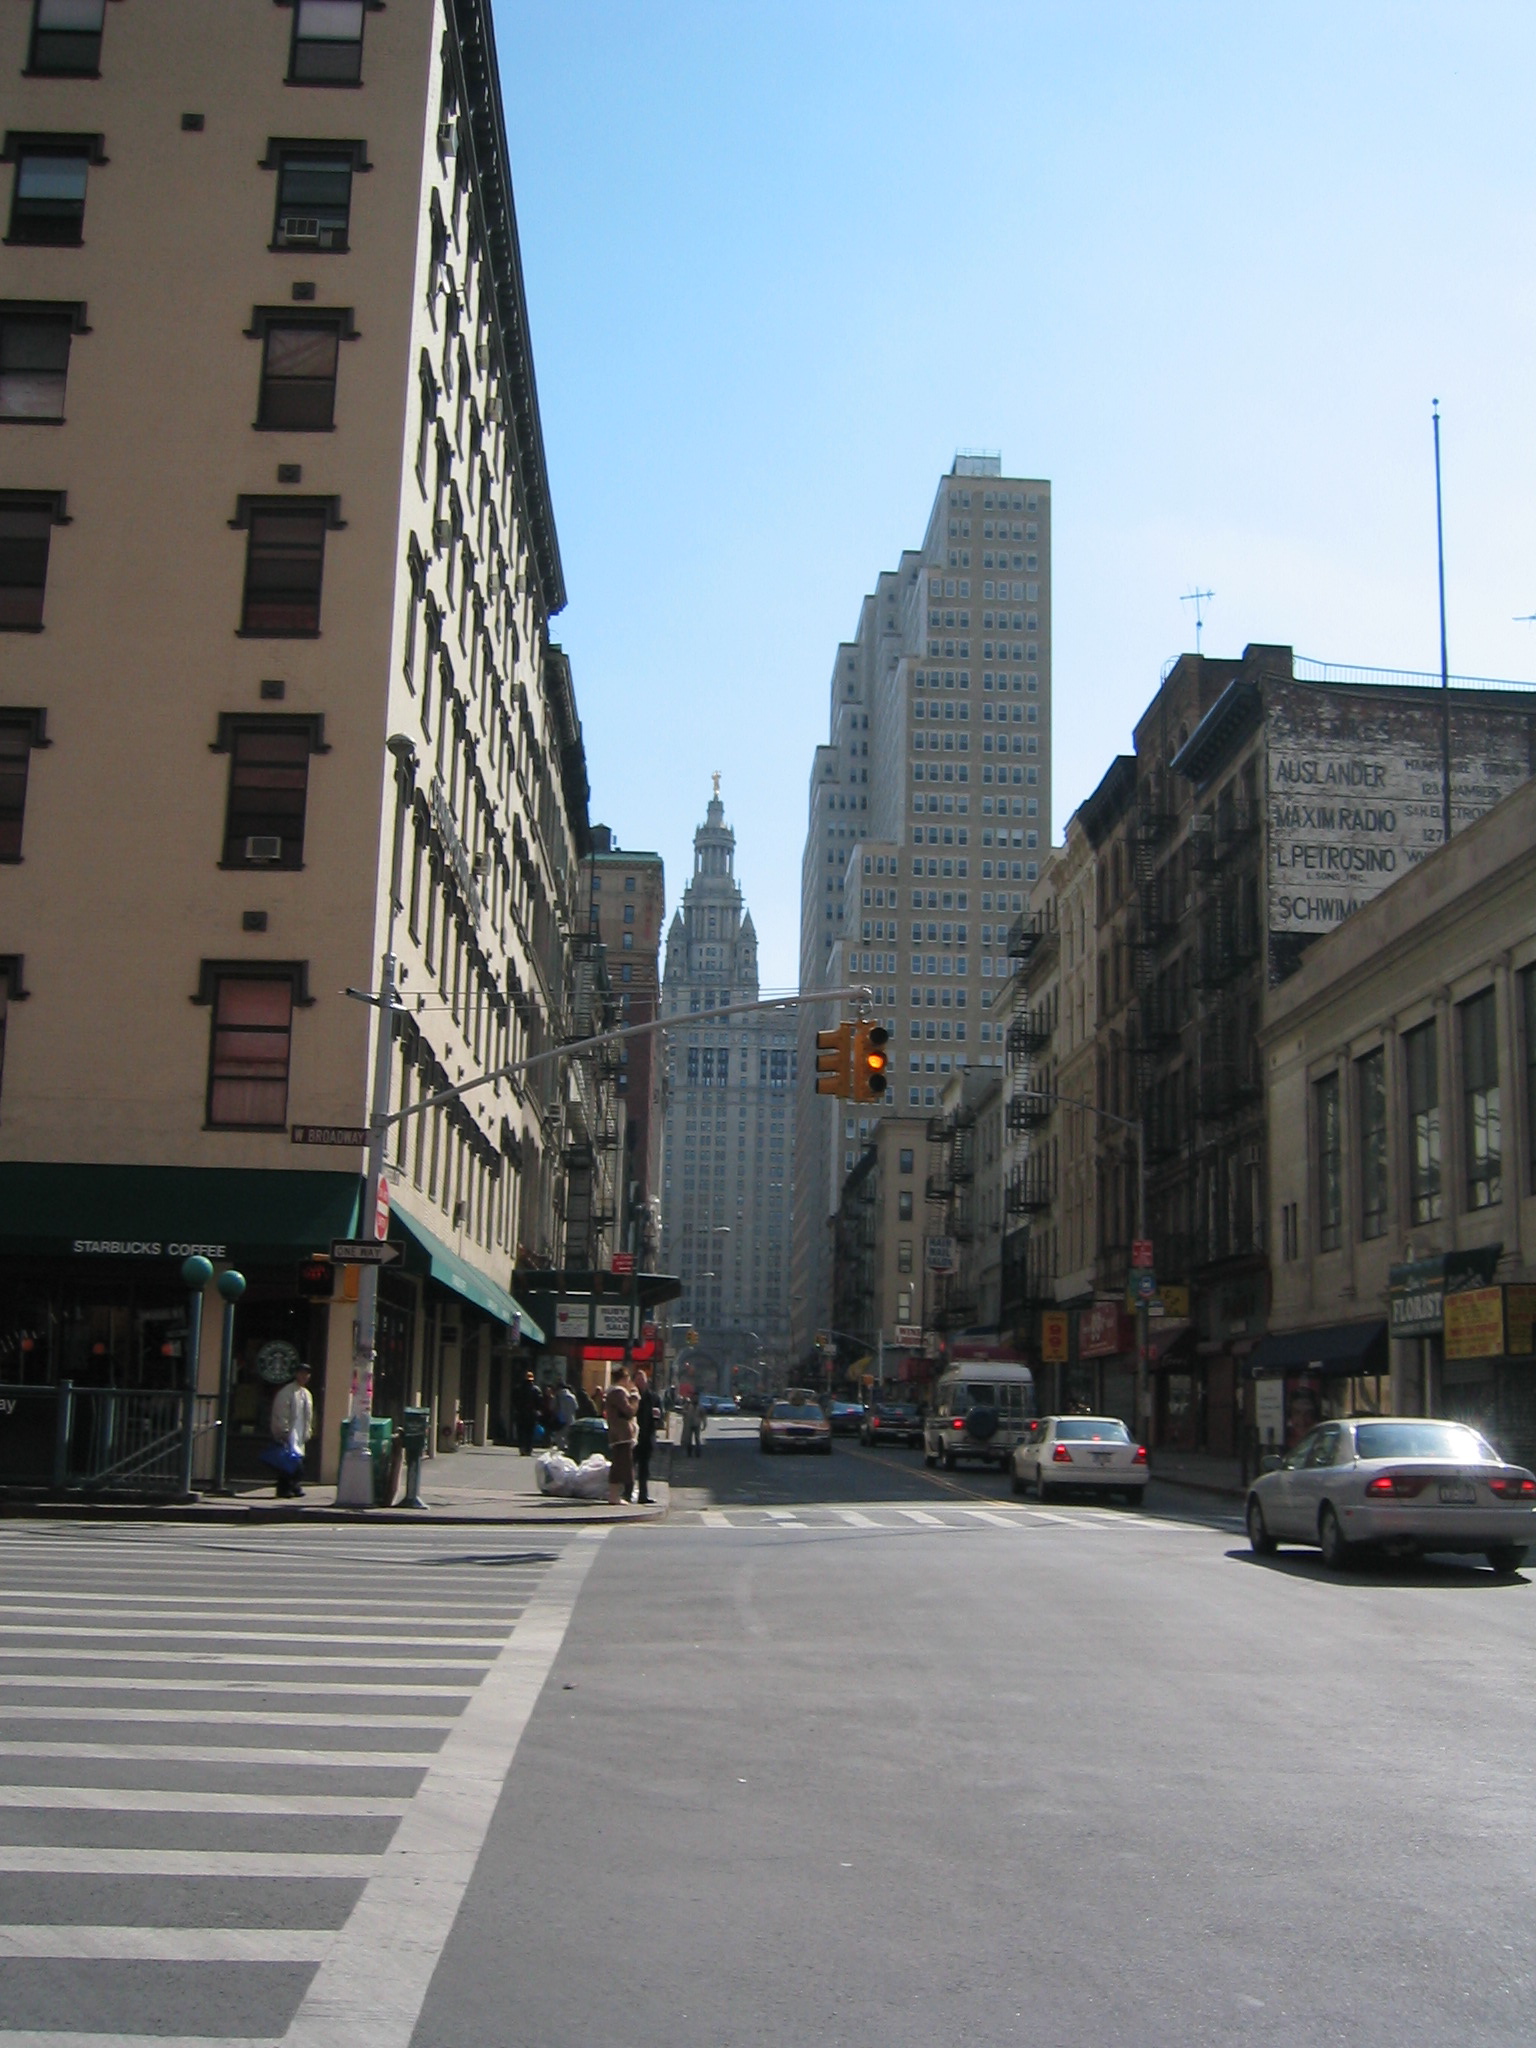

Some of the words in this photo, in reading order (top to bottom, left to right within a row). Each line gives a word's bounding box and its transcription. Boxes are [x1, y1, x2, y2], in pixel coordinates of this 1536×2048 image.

[1275, 760, 1386, 787] AUSLANDER
[1275, 805, 1335, 829] MAXIM
[1339, 807, 1397, 832] RADIO
[1423, 829, 1443, 841] 127
[293, 1129, 304, 1142] W
[308, 1129, 365, 1144] BROADWAY
[73, 1240, 161, 1255] STARBUCKS
[168, 1243, 227, 1258] COFFEE
[337, 1246, 356, 1257] ONE
[361, 1247, 382, 1258] WAY
[1392, 1292, 1442, 1322] FLORIST
